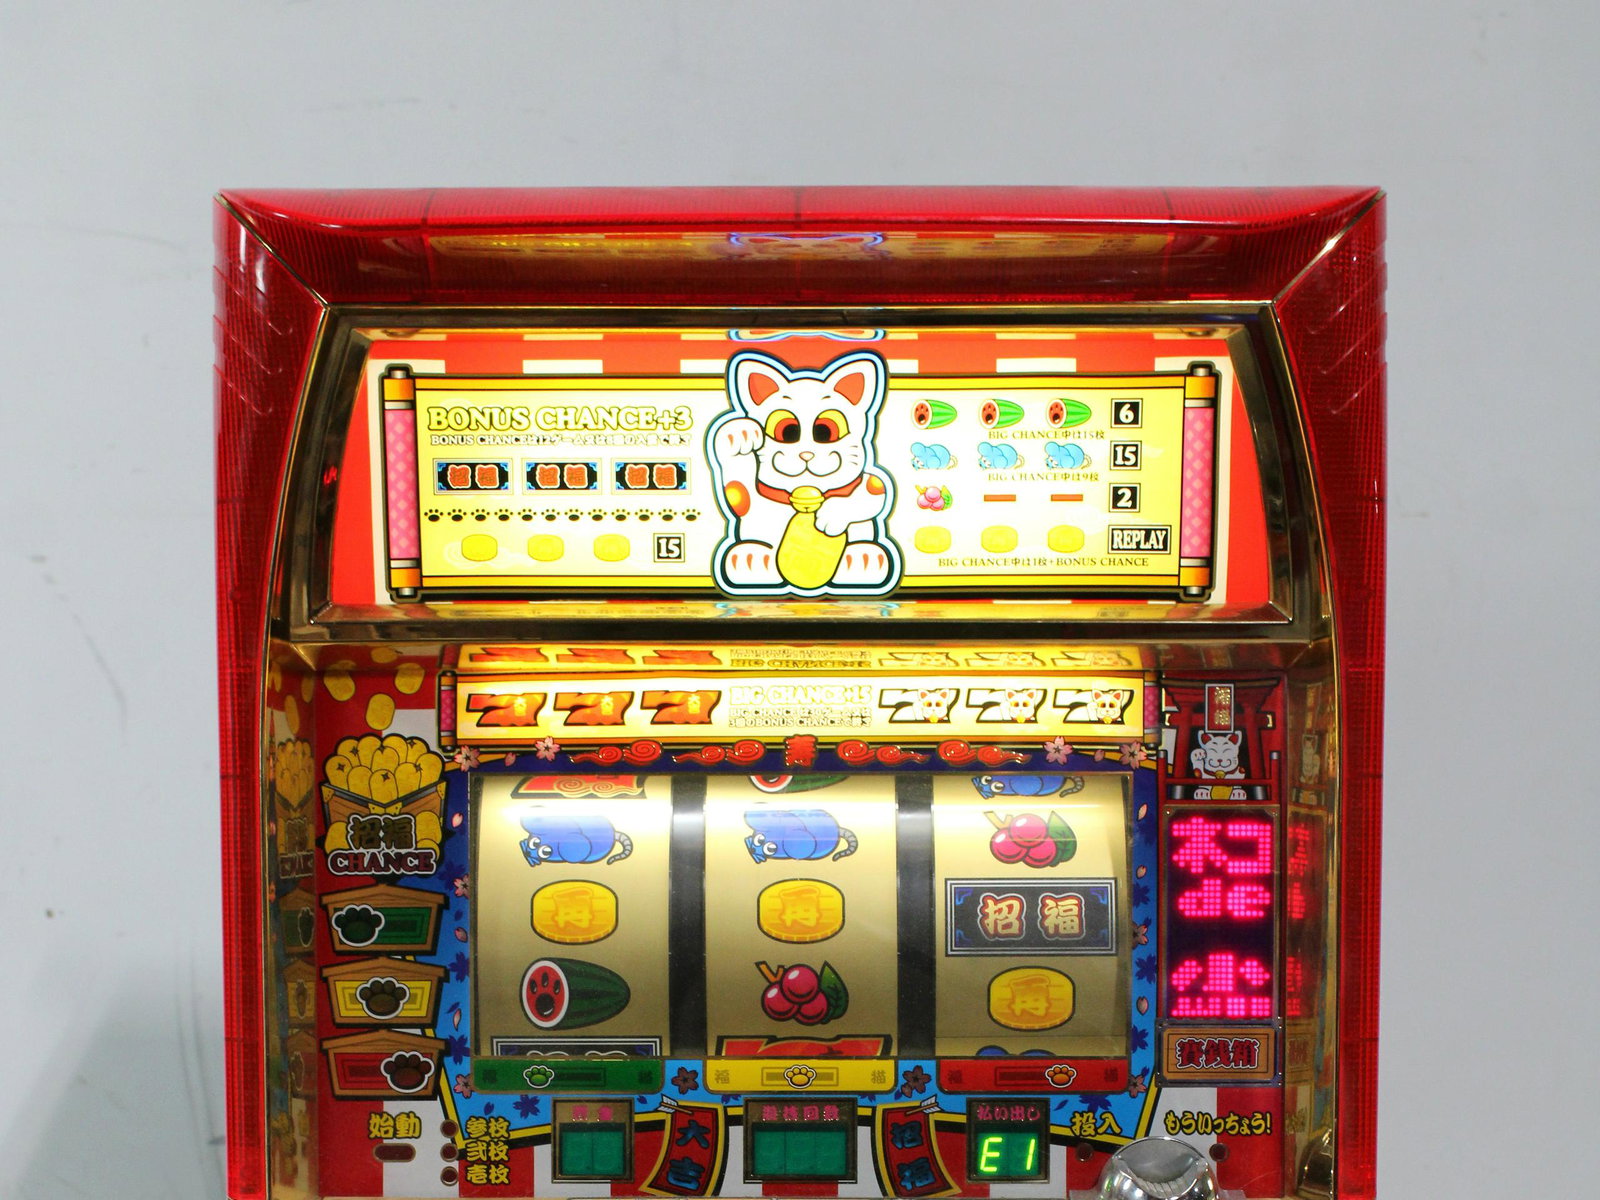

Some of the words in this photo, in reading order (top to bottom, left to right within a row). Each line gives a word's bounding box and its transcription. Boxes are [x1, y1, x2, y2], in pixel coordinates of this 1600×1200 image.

[427, 406, 531, 432] BONUS
[535, 405, 694, 432] CHANCE+3
[1119, 403, 1135, 423] 6
[431, 434, 475, 446] BONUS
[988, 430, 1010, 441] BIG
[1115, 445, 1137, 466] 15
[988, 472, 1010, 482] BIG
[1117, 487, 1133, 508] 2
[658, 537, 682, 560] 15
[1112, 530, 1166, 550] REPLAY
[937, 556, 958, 567] BIG
[1100, 556, 1149, 567] CHANCE
[729, 686, 765, 706] BIG
[1171, 816, 1272, 875] ネコ
[329, 850, 437, 875] CHANCE
[1177, 878, 1271, 919] de
[978, 893, 1086, 940] 招福
[368, 1111, 422, 1139] 始動
[1071, 1111, 1122, 1137] 投入
[666, 1121, 711, 1191] 大吉
